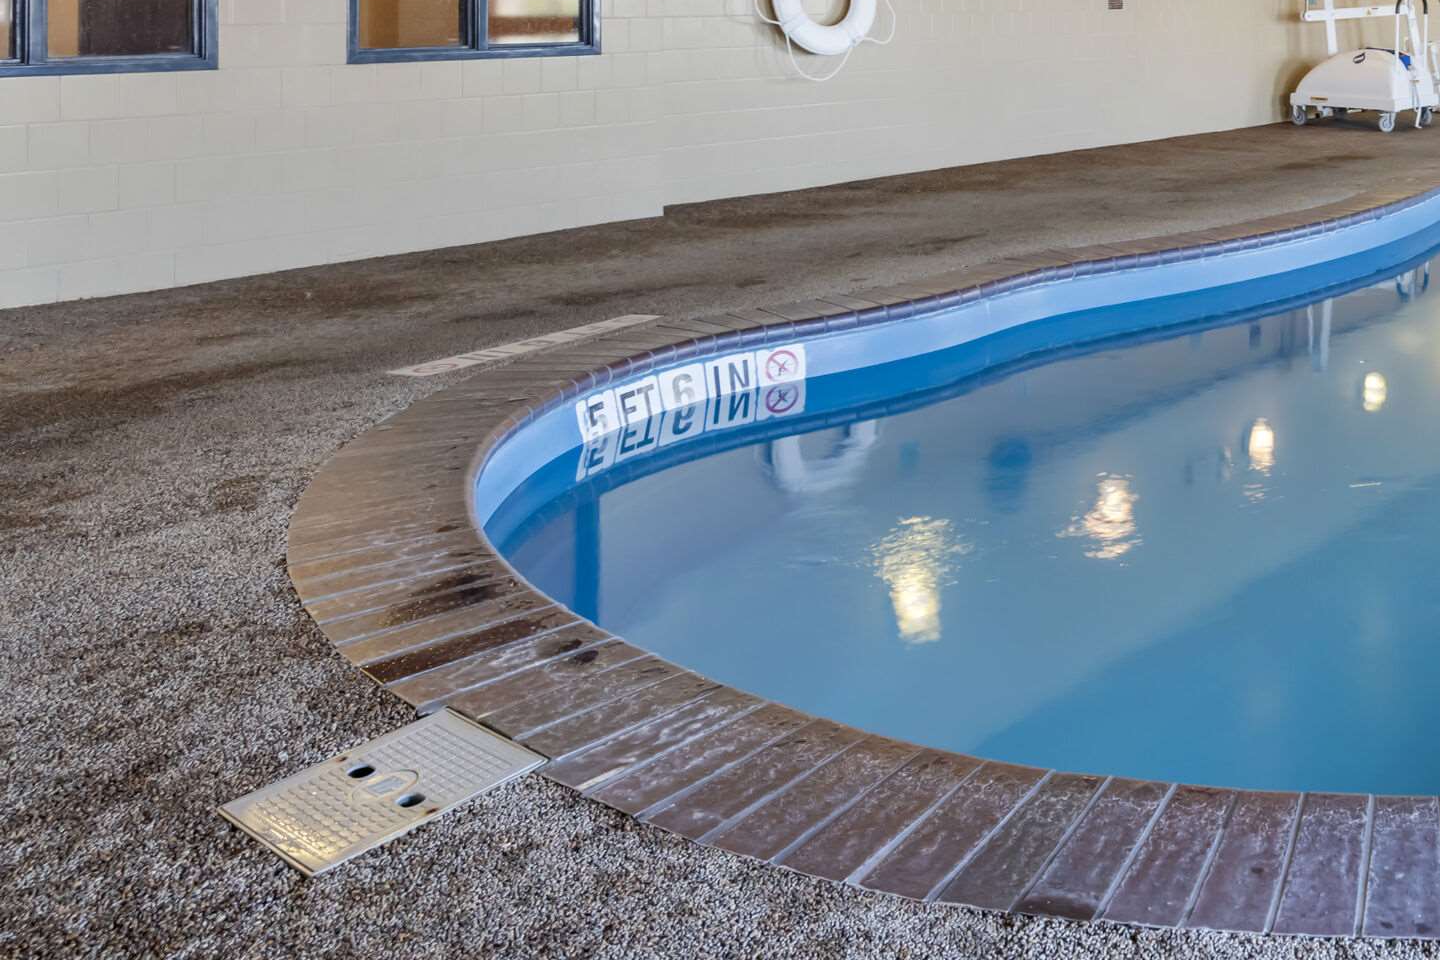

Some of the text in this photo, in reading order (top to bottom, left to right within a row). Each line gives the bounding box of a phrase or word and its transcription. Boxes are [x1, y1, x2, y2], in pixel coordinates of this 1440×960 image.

[620, 383, 654, 426] FT
[672, 373, 695, 408] 6
[713, 359, 751, 396] IN
